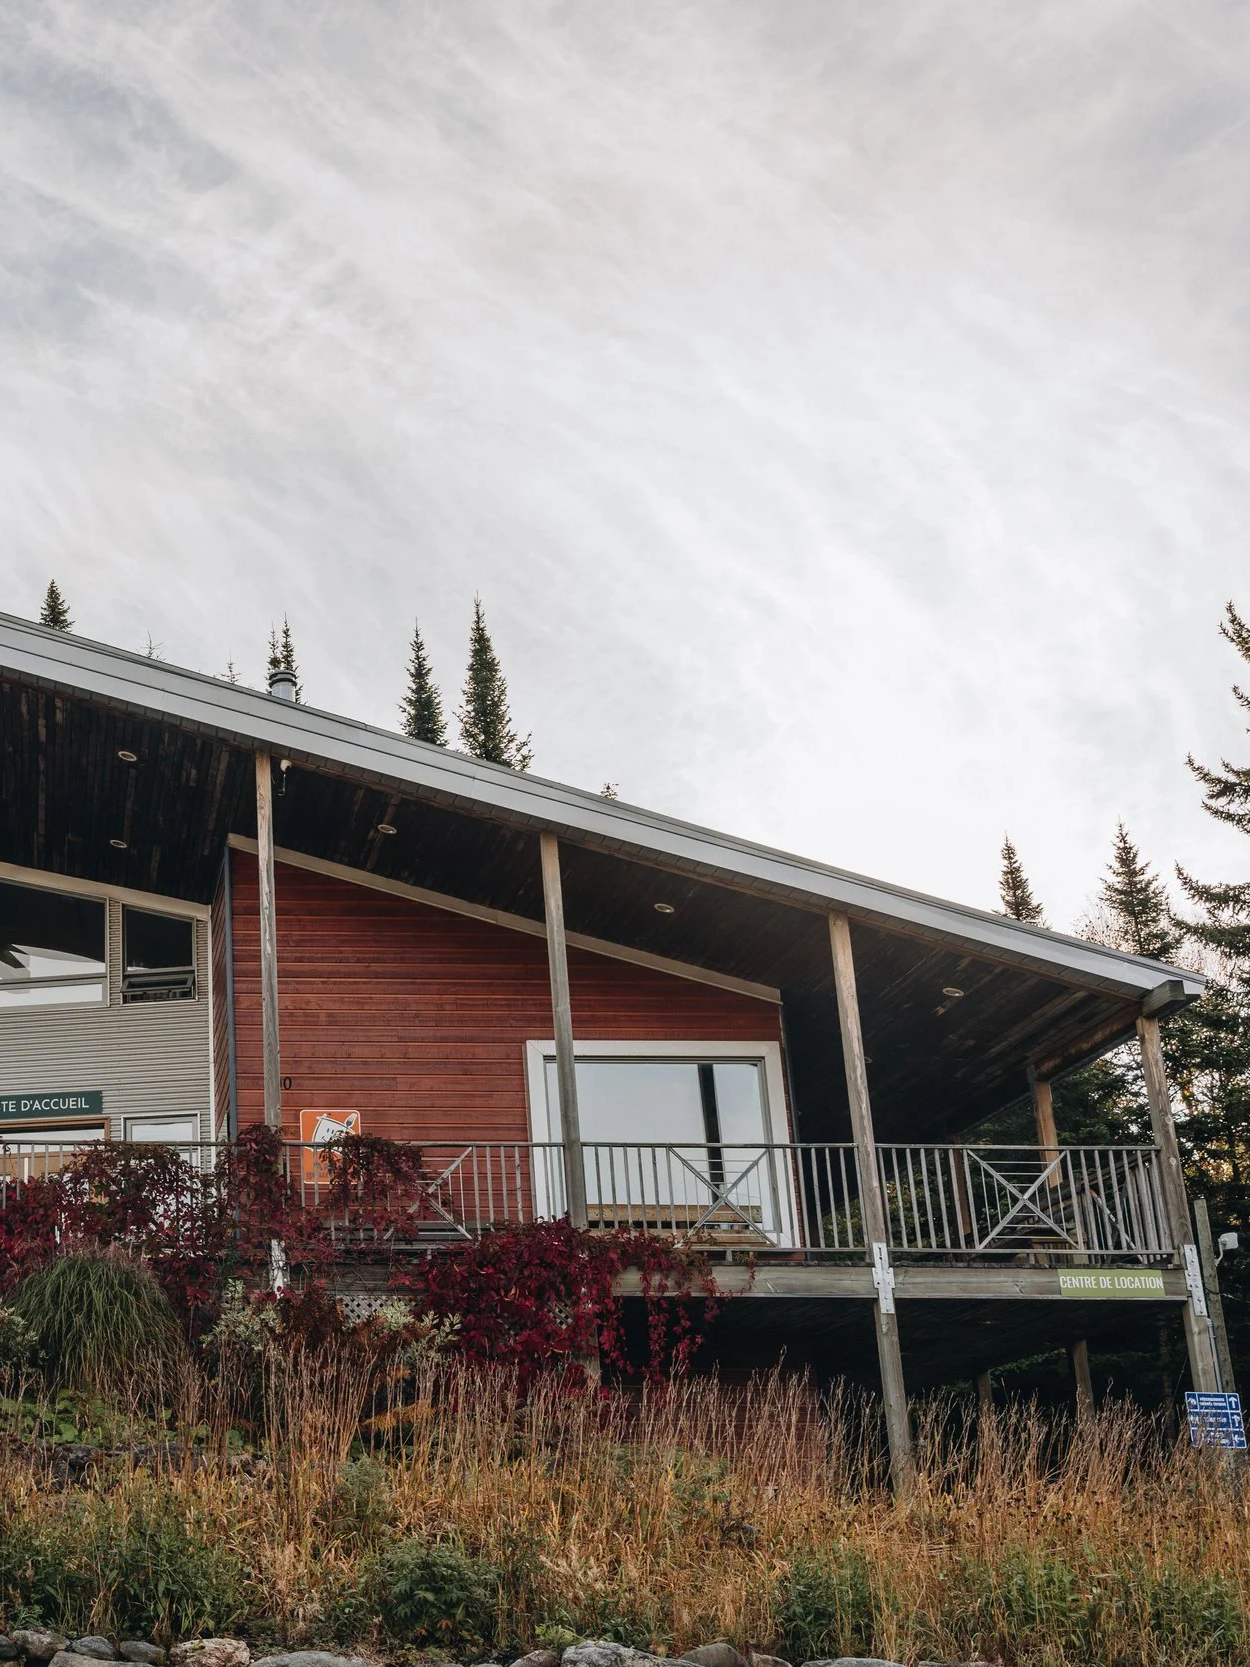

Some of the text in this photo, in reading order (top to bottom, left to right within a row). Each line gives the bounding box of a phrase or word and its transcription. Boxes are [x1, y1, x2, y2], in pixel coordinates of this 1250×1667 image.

[21, 1098, 89, 1112] D'ACCUEIL
[1059, 1276, 1164, 1289] CENTRE DE LOCATION
